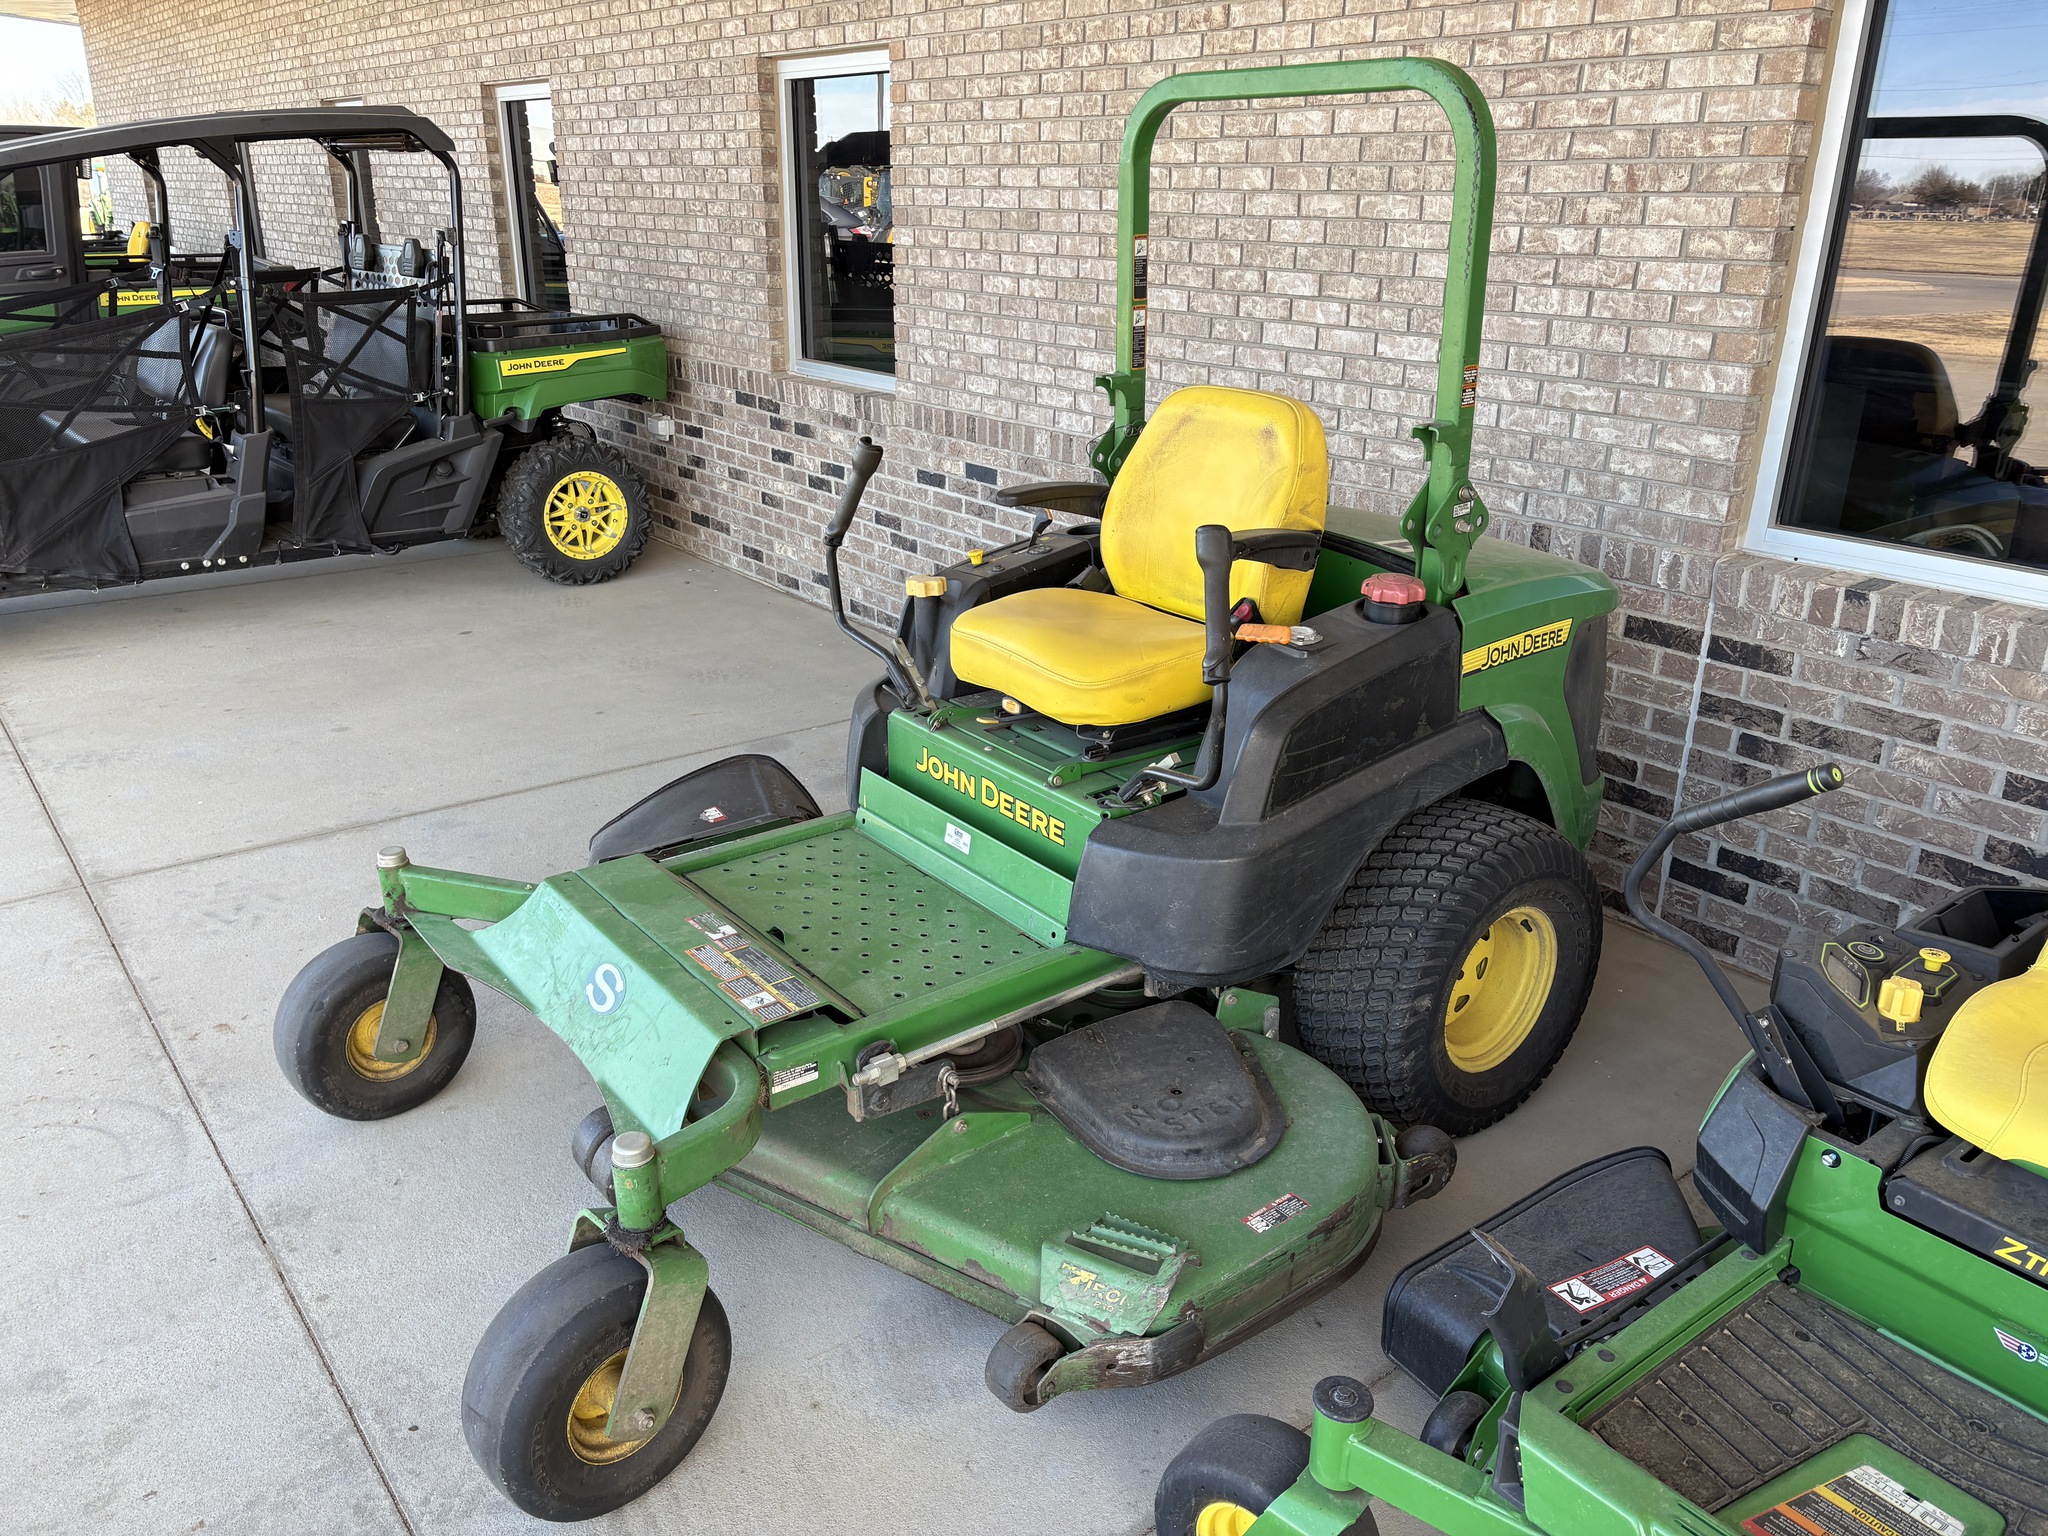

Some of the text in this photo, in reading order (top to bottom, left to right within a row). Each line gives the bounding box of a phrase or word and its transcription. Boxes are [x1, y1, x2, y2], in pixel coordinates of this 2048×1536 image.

[507, 359, 565, 371] JOHN DEERE
[1481, 628, 1564, 668] JOHN DEERE
[916, 746, 1066, 847] JOHN DEERE
[1123, 1097, 1182, 1126] NO
[1608, 1281, 1642, 1298] DANGER
[530, 1419, 563, 1501] CARLSTAR
[1851, 1507, 1895, 1536] CAUTION
